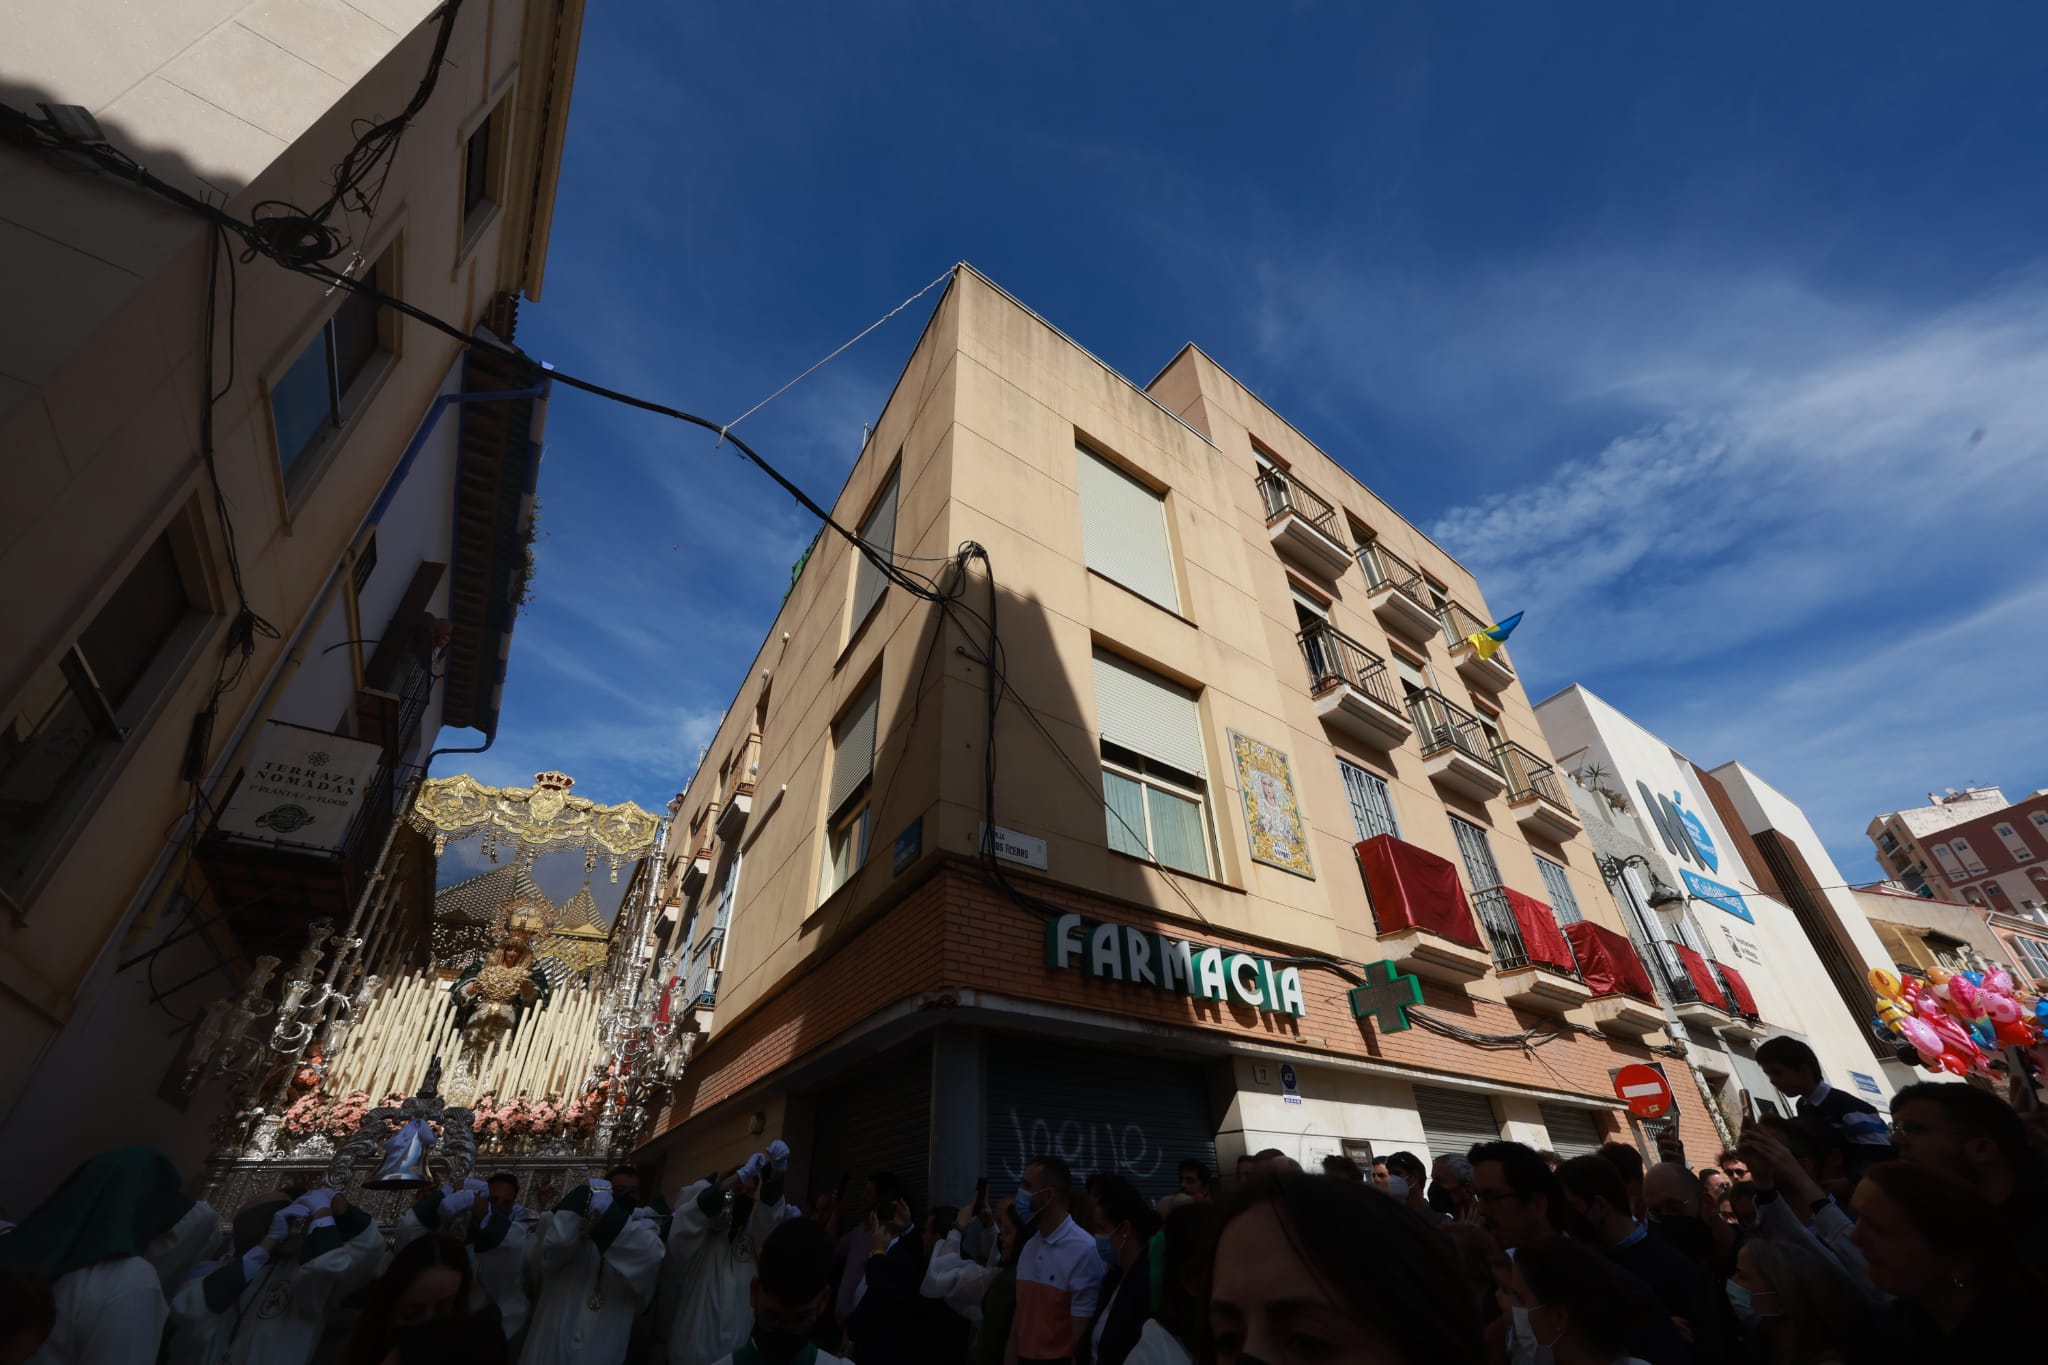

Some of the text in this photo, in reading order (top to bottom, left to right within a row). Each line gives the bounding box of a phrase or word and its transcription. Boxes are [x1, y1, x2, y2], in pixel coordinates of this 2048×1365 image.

[255, 770, 354, 796] NOMADAS
[264, 761, 355, 786] TERRAZA
[258, 785, 298, 799] PLANTA
[1048, 913, 1306, 1018] FARMACIA
